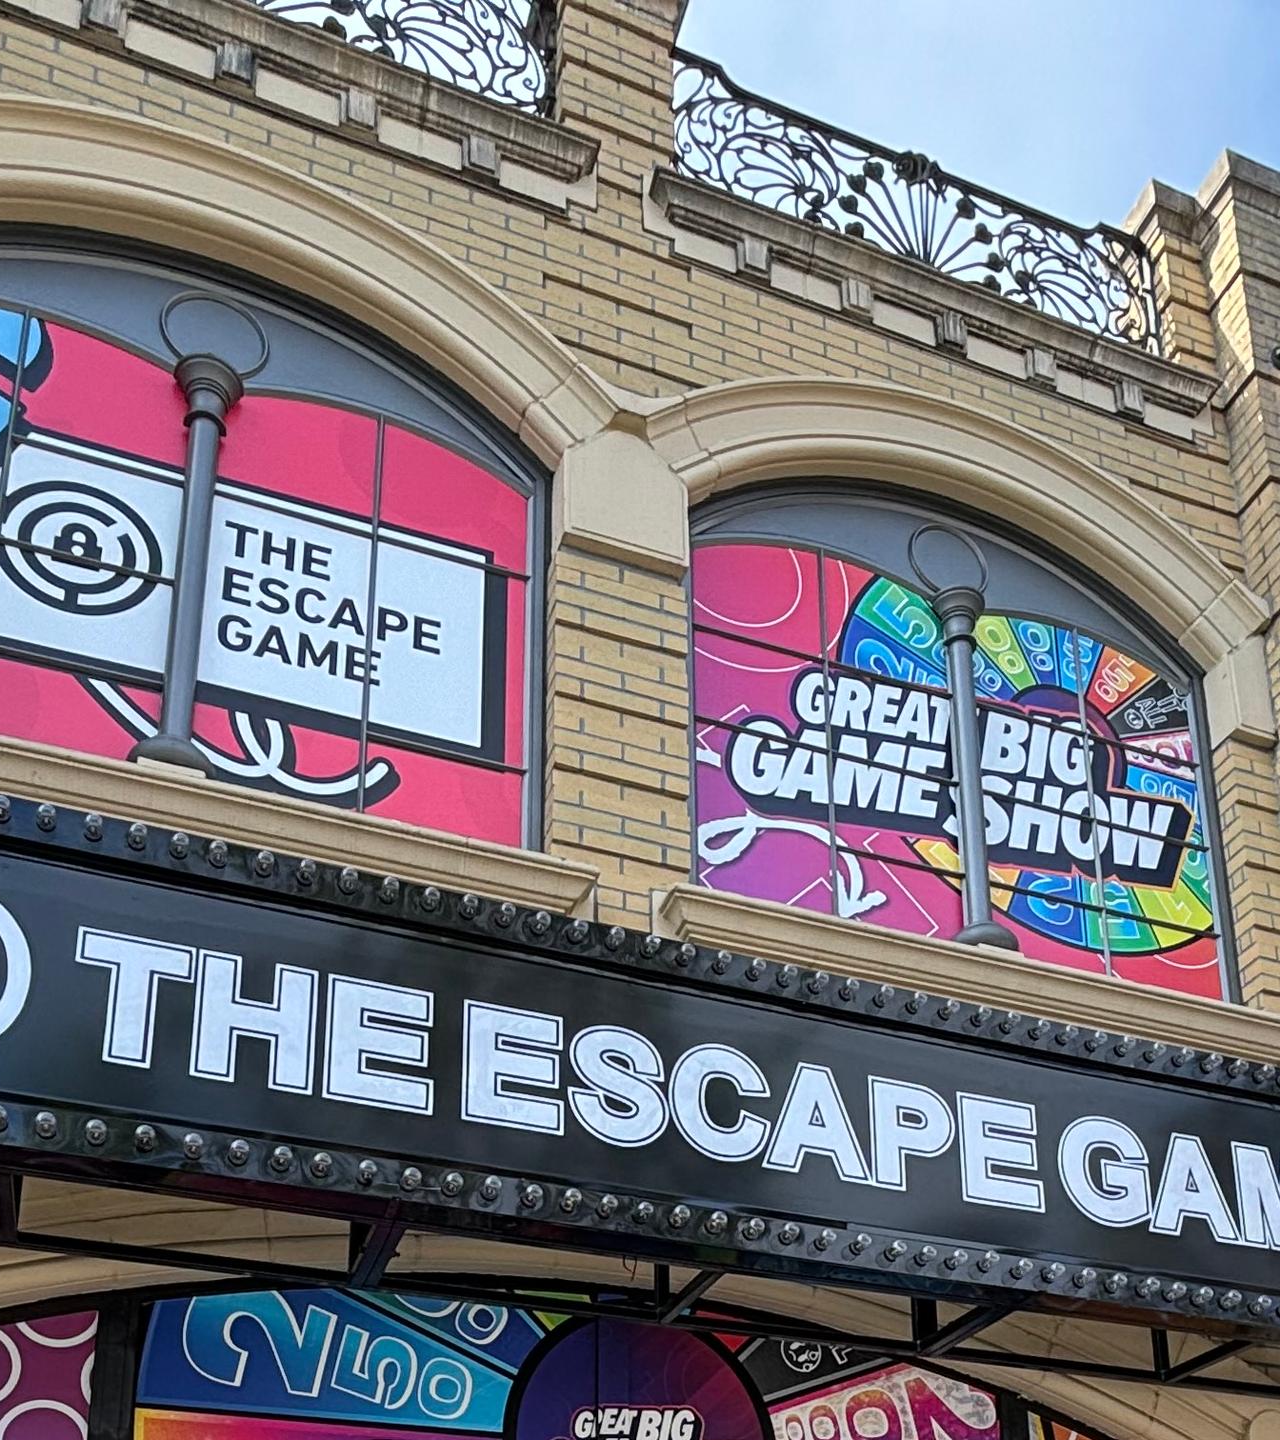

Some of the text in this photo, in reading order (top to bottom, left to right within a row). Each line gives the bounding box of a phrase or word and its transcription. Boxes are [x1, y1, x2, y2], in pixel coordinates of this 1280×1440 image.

[225, 521, 332, 581] THE
[217, 615, 381, 686] GAME
[222, 570, 442, 654] ESCAPE
[795, 672, 952, 746] GREAT
[980, 711, 1094, 786] BIG
[732, 721, 1175, 870] GAME SHOW
[74, 925, 436, 1115] THE
[460, 999, 1045, 1212] ESCAPE
